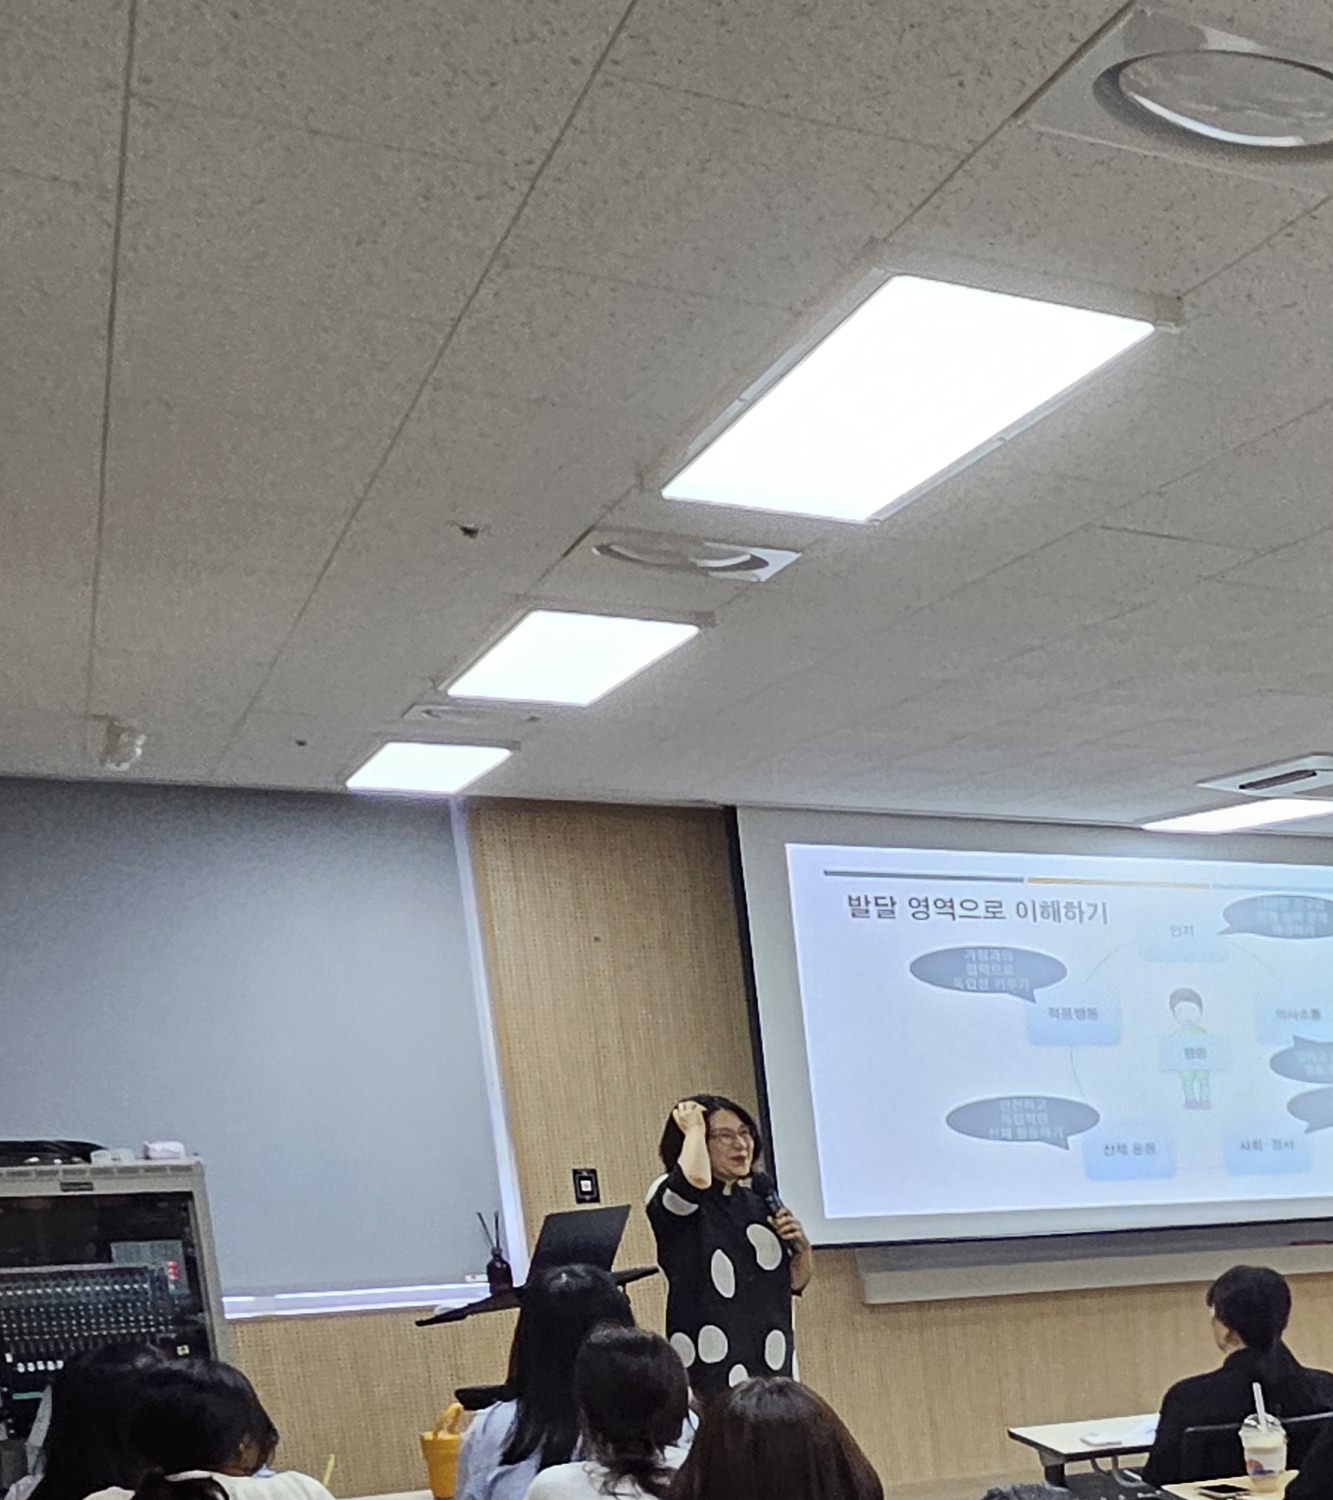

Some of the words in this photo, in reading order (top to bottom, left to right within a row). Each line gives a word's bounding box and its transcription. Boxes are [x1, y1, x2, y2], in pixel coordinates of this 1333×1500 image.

[847, 895, 897, 919] 발달
[907, 896, 1006, 921] 영역으로
[1016, 899, 1109, 925] 이해하기
